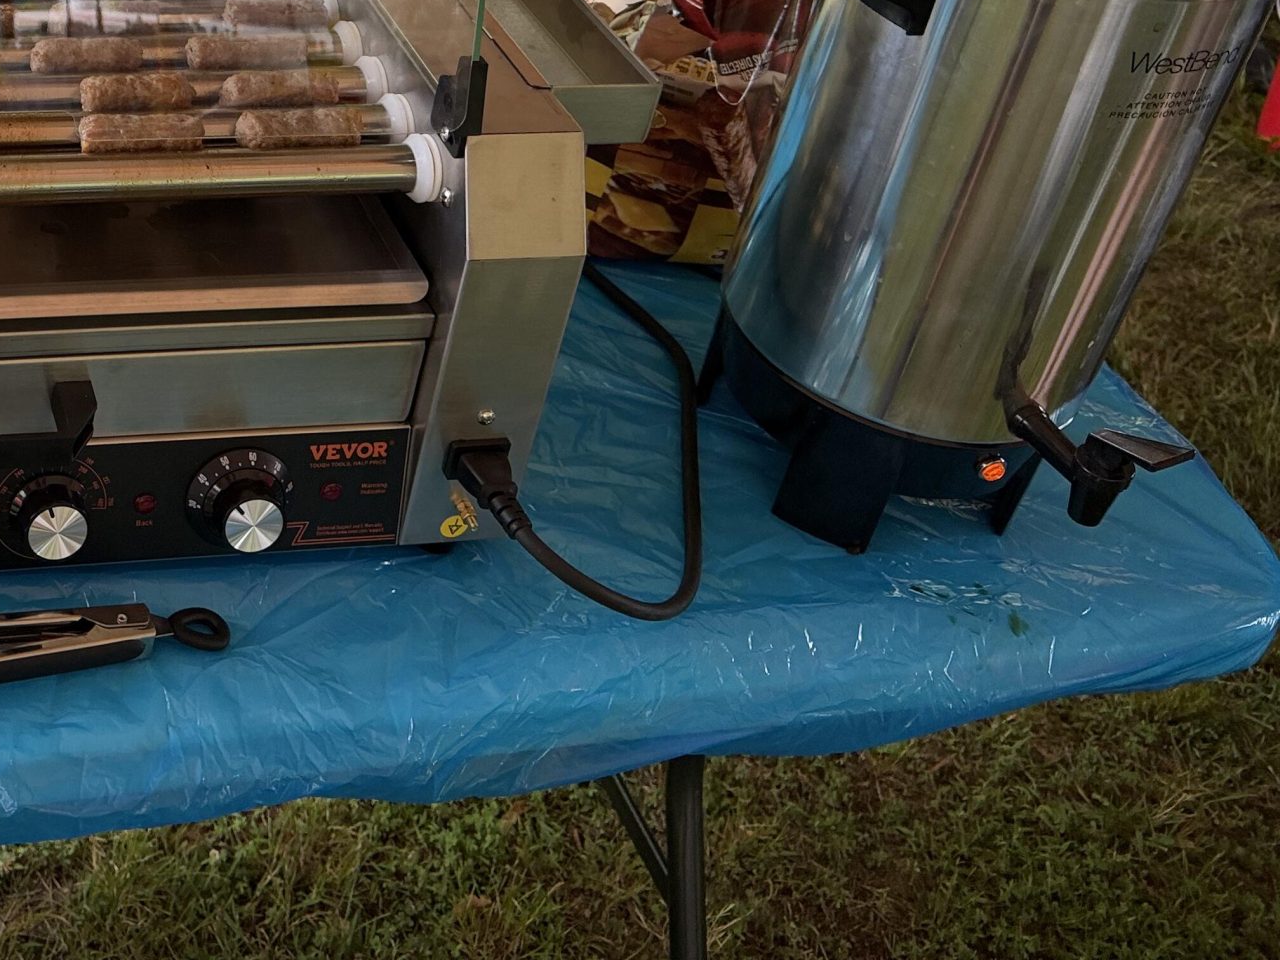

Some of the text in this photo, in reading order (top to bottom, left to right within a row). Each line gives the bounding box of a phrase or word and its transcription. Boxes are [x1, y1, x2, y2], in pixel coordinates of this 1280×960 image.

[1144, 90, 1187, 101] CAUTION
[1126, 100, 1182, 110] ATTENTION
[310, 441, 388, 460] VEVOR
